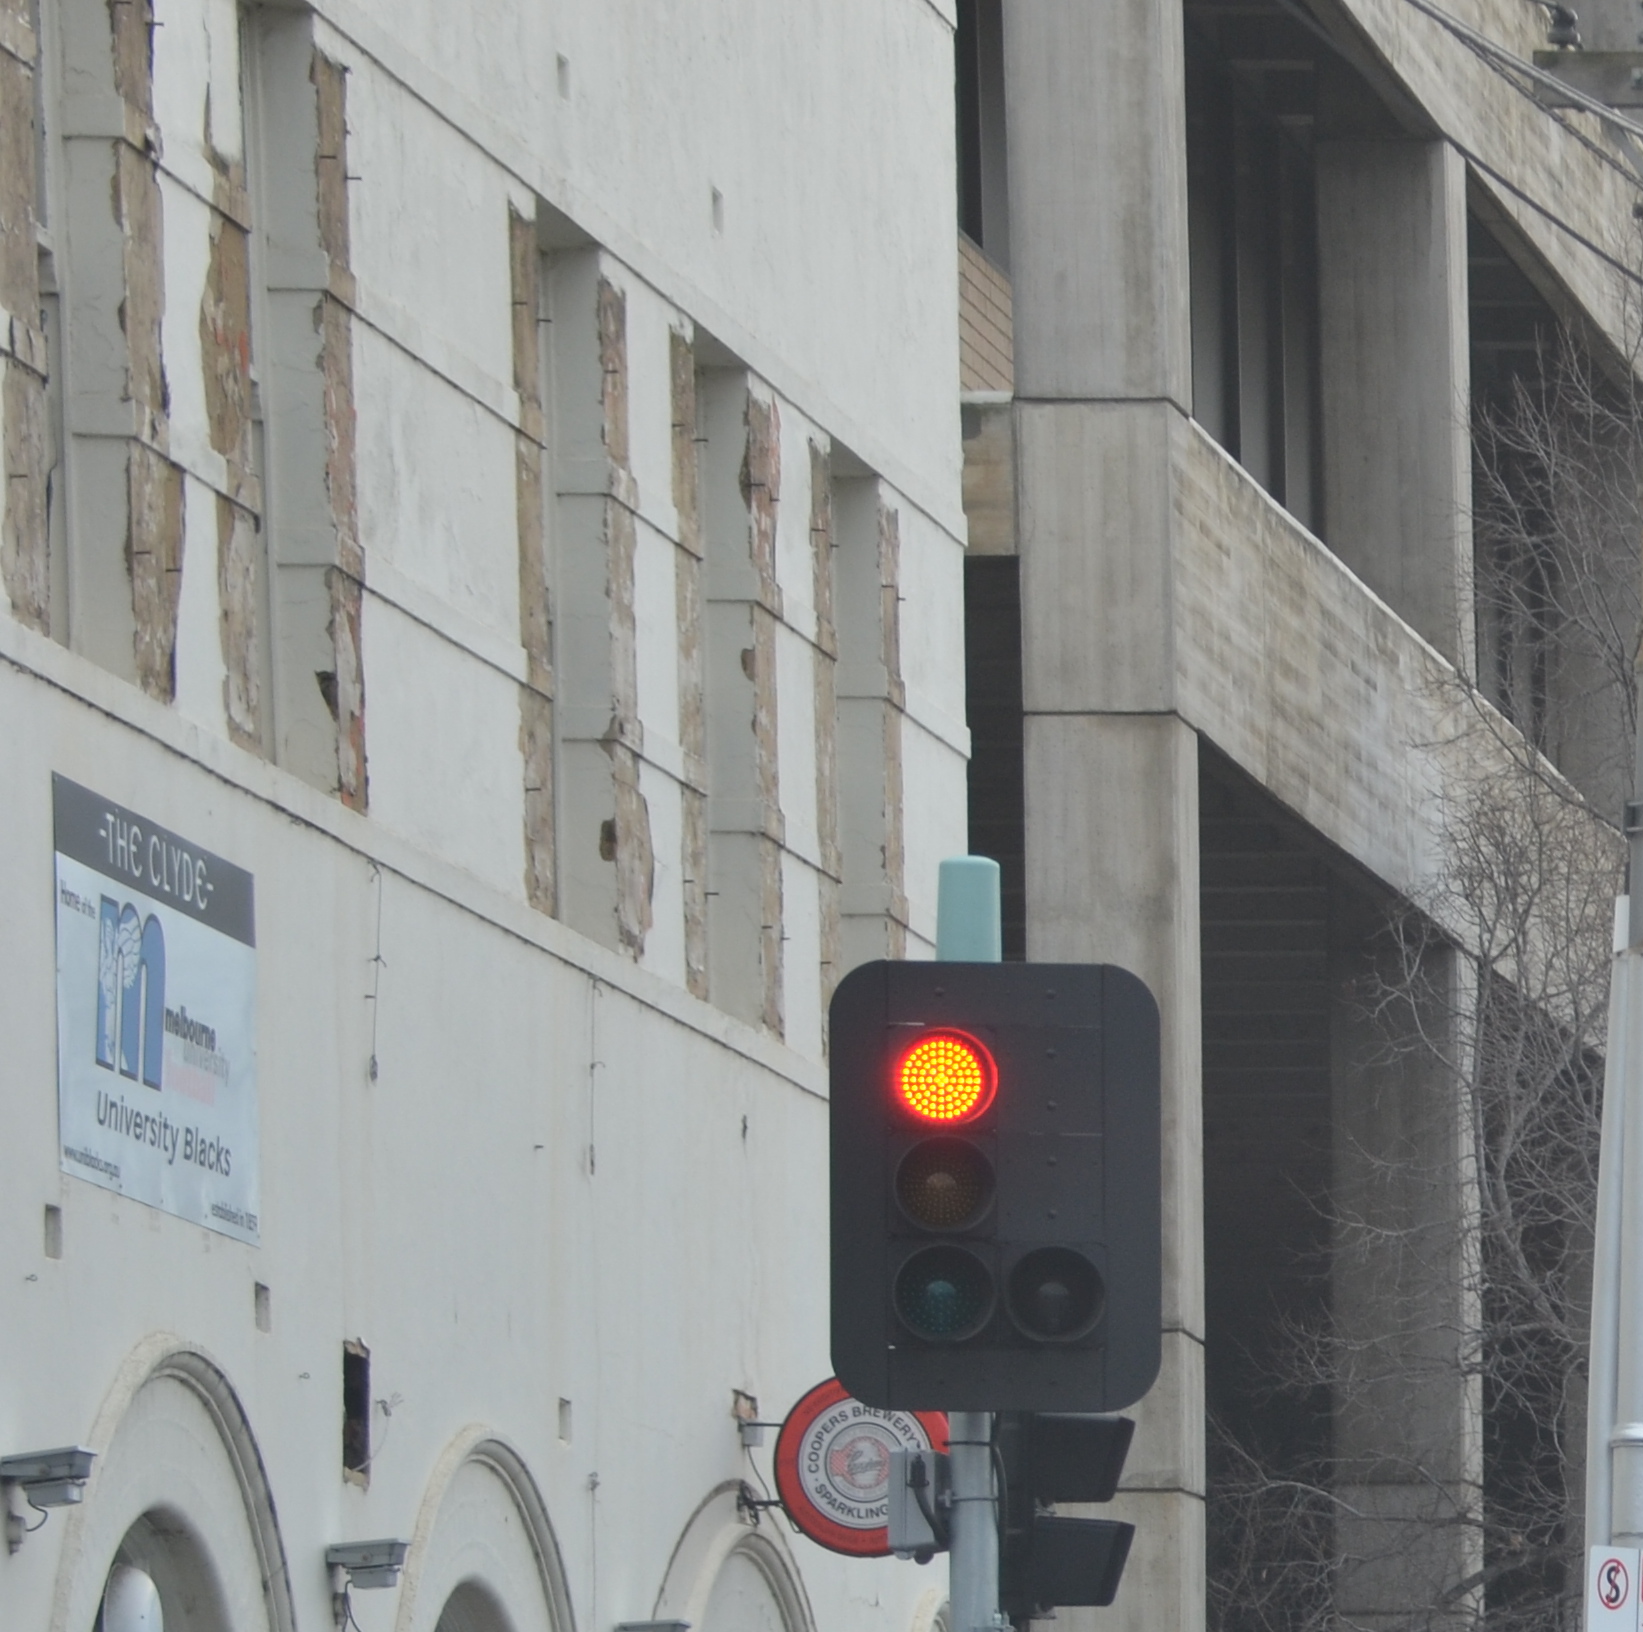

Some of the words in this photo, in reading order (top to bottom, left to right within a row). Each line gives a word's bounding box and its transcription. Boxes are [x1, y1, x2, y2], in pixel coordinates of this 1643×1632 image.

[165, 1005, 216, 1052] melbourne
[97, 1090, 180, 1165] University
[184, 1127, 232, 1177] Blacks
[808, 1410, 849, 1474] COOPERS
[852, 1406, 917, 1443] BREWERY
[815, 1482, 889, 1519] SPARKLING
